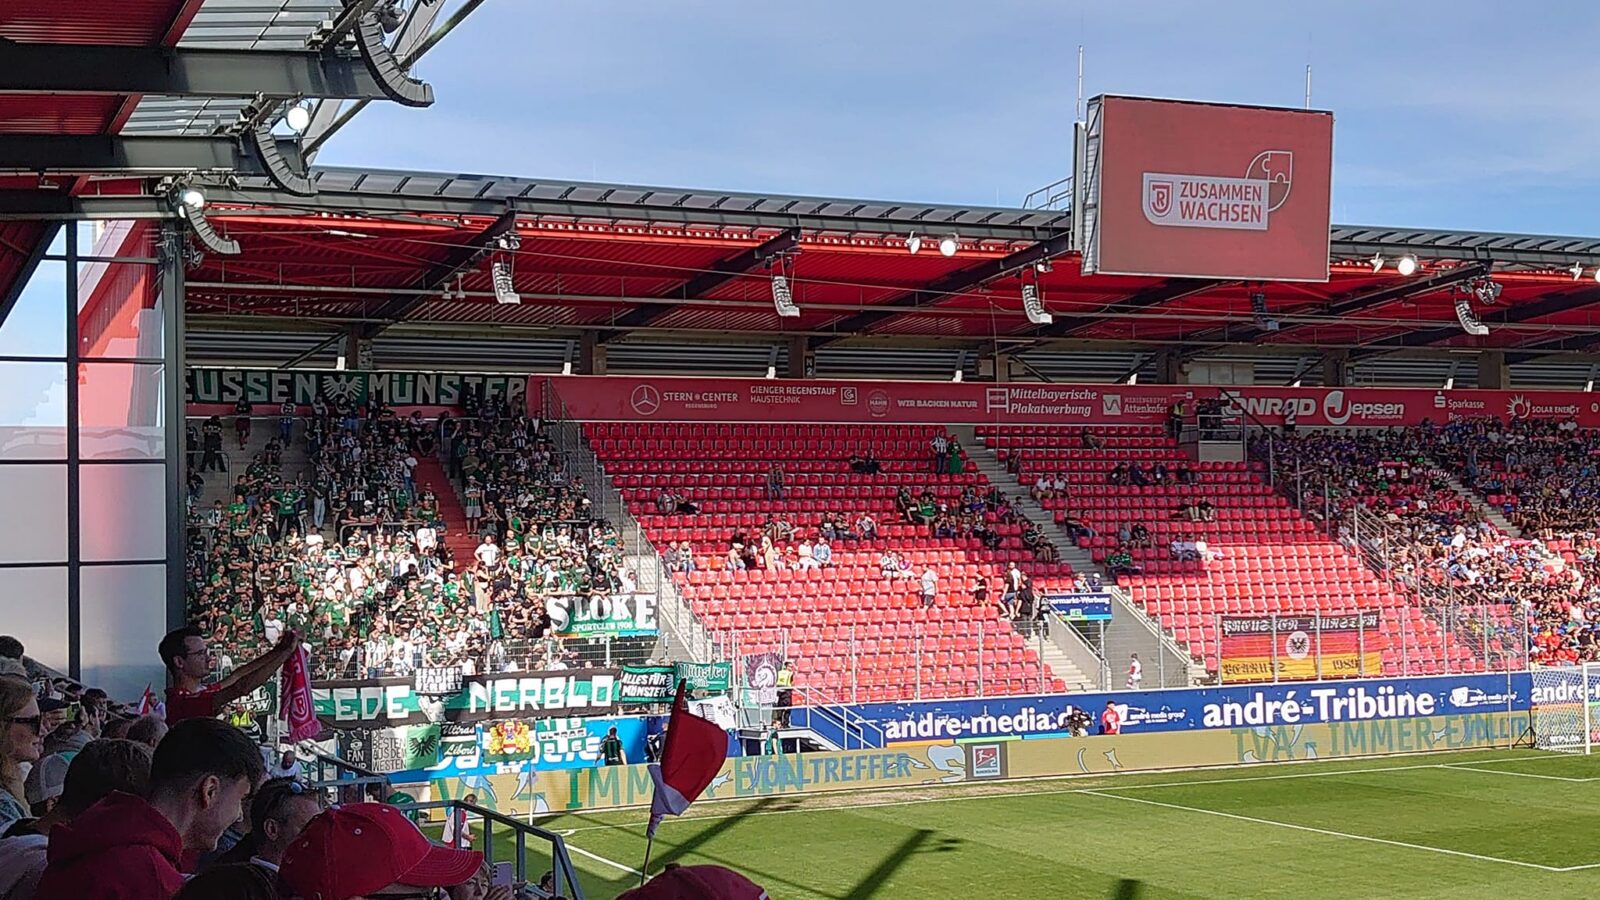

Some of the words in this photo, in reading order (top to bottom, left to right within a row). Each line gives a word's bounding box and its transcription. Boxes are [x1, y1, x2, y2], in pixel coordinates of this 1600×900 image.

[1180, 182, 1262, 202] ZUSAMMEN
[1180, 201, 1261, 223] WACHSEN
[751, 386, 785, 394] GIENGER
[786, 386, 837, 395] REGENSTAUF
[1010, 388, 1097, 402] Mittelbayerische
[663, 392, 693, 401] STERN
[701, 392, 738, 402] CENTER
[751, 395, 800, 404] HAUSTECHNIK
[897, 399, 915, 408] WIR
[917, 399, 949, 408] BACKEN
[950, 399, 978, 408] NATUR
[1010, 402, 1092, 417] Plakatwerbung
[1124, 404, 1168, 414] Attenkofer
[1323, 391, 1404, 425] Jepsen
[1448, 399, 1485, 410] Sparkasse
[1554, 405, 1581, 414] ENERGY
[546, 594, 657, 632] SLOKE
[571, 622, 616, 632] SPORTCLUB
[622, 672, 648, 685] ALLES
[648, 672, 667, 685] FÜR
[622, 685, 667, 697] MÜNSTER
[1203, 688, 1436, 728] andré-Tribüne
[886, 706, 1073, 739] andre-media.d
[442, 724, 476, 736] Ultras
[1328, 717, 1434, 756] IMMER
[347, 749, 364, 762] FAN
[373, 759, 407, 771] WESTEN
